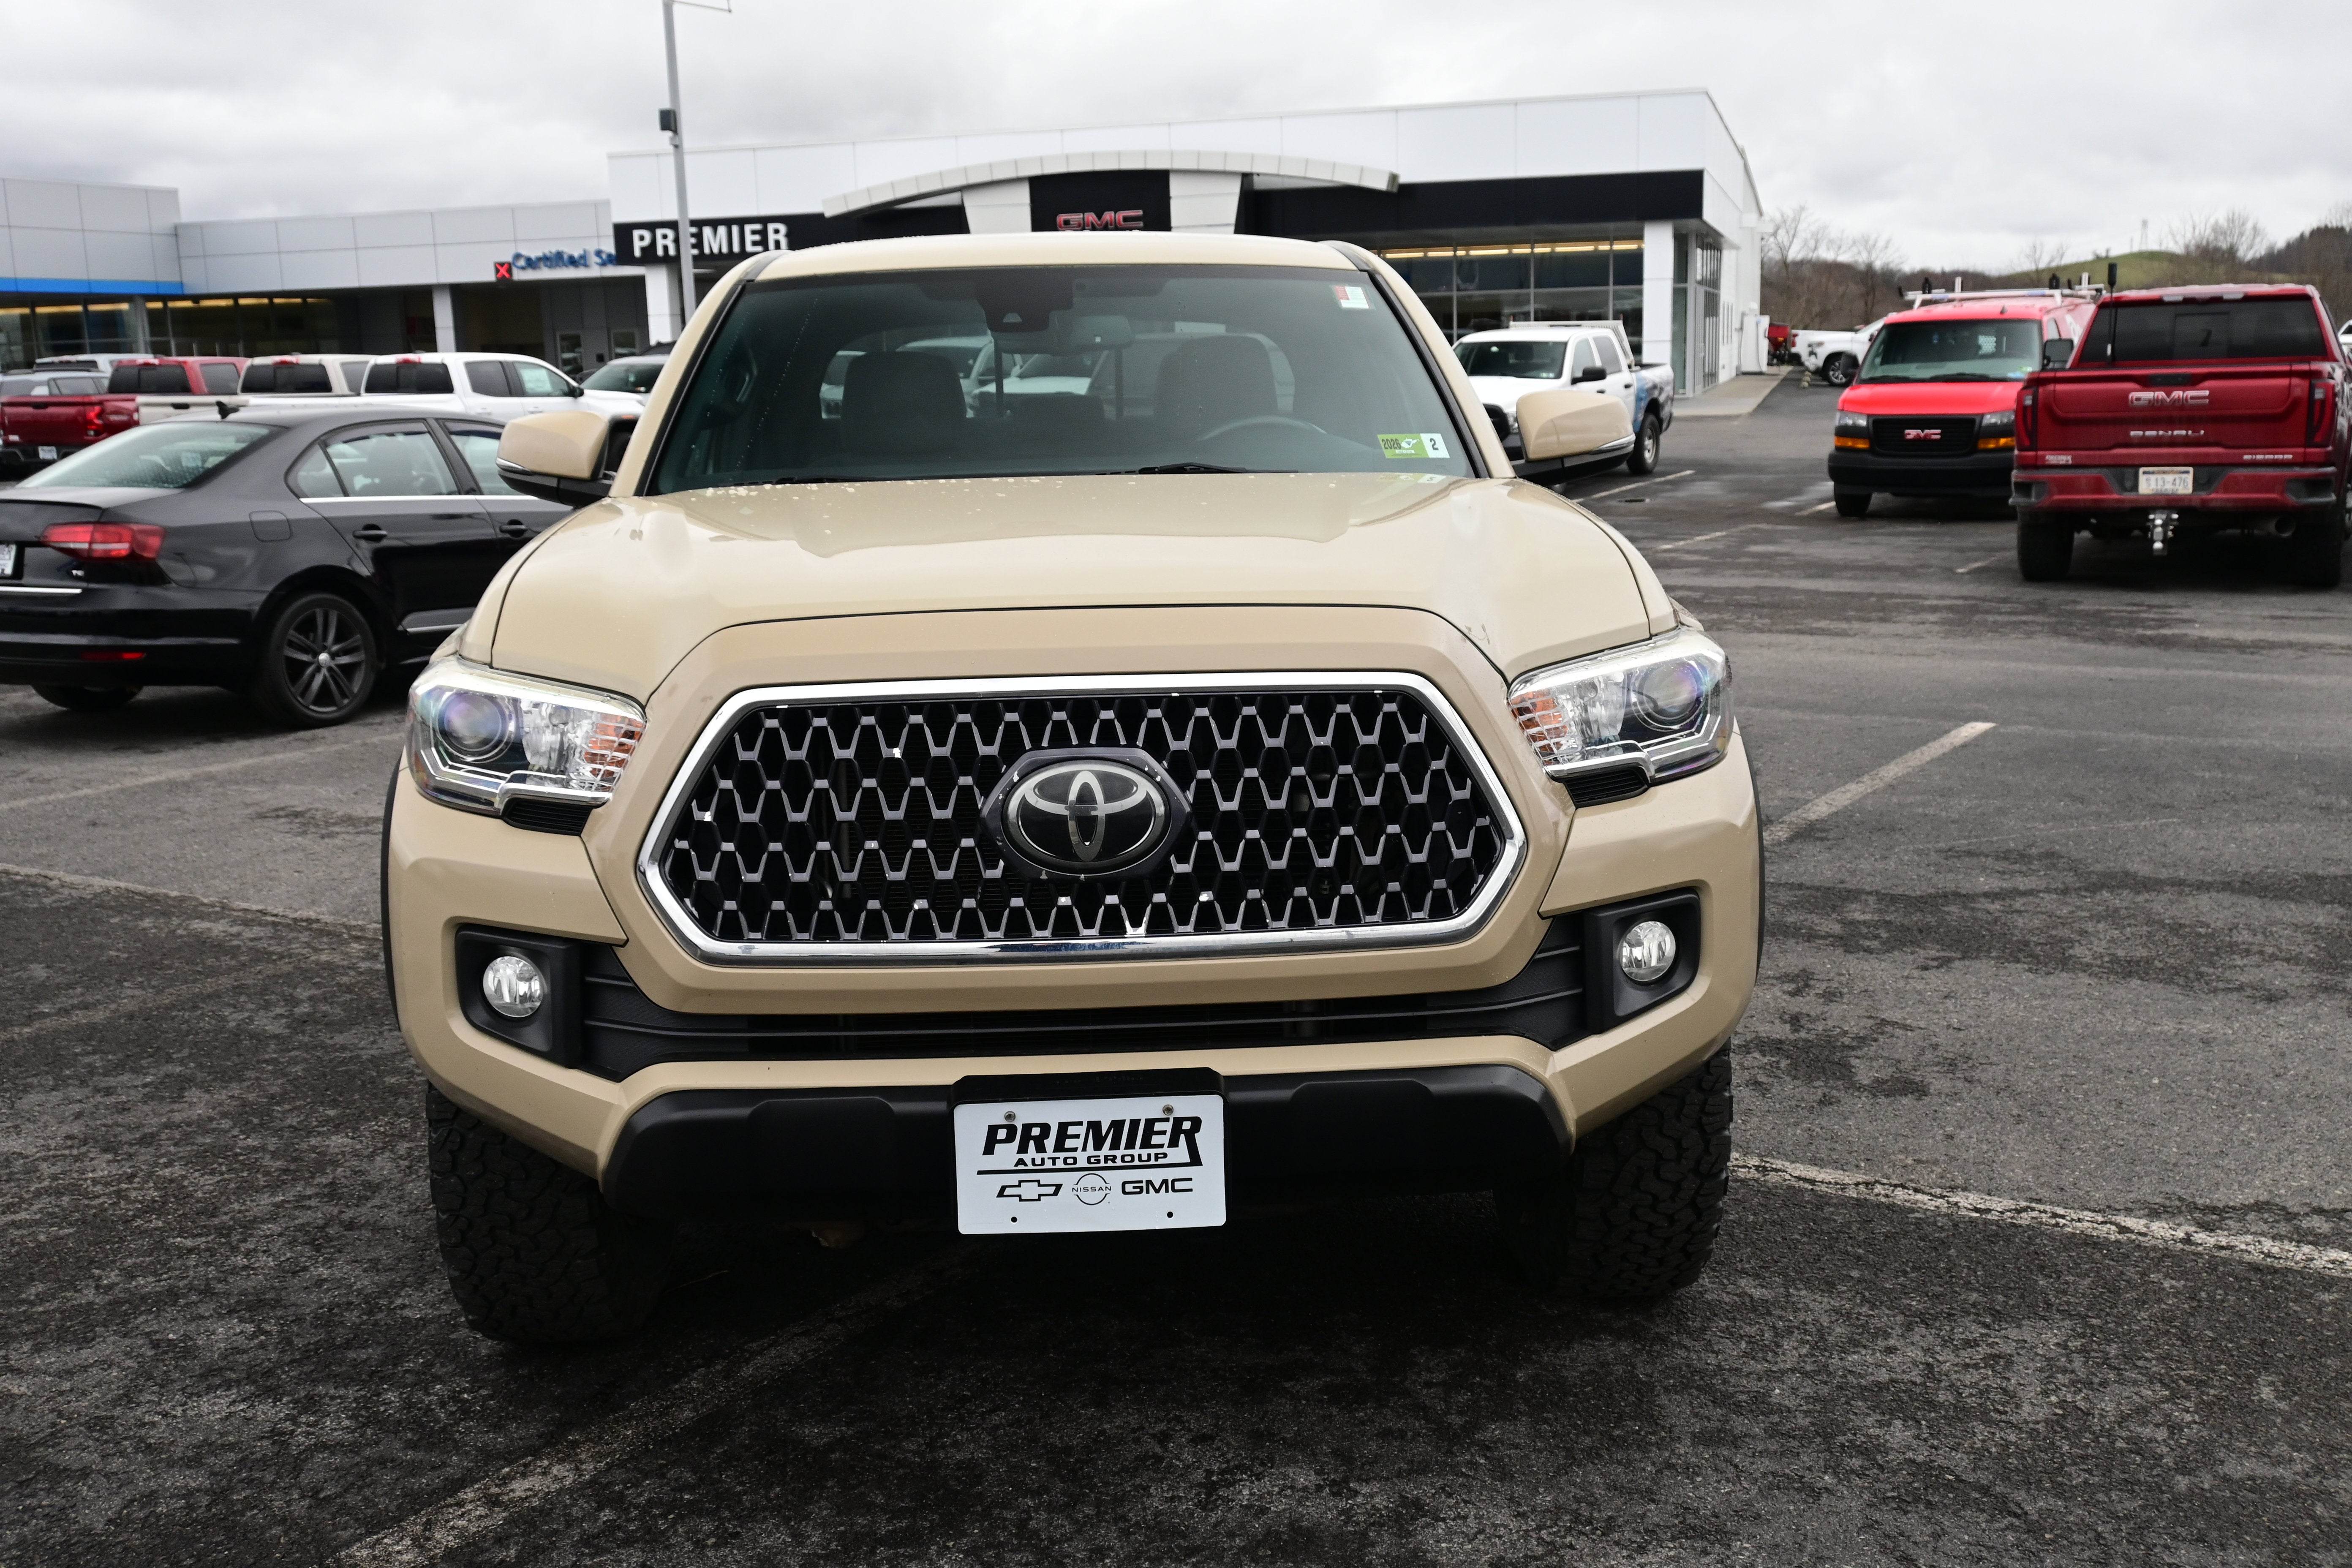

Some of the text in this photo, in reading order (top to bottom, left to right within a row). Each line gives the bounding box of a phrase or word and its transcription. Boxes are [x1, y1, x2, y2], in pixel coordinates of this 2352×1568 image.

[1056, 210, 1143, 230] GMC
[632, 223, 789, 258] PREMIER
[512, 248, 589, 270] Certified
[2129, 390, 2209, 406] GMC
[1904, 429, 1941, 439] GMC
[1382, 438, 1401, 449] 2026
[1430, 438, 1439, 450] 2
[982, 1116, 1203, 1166] PREMIER
[1014, 1152, 1168, 1167] AUTO GROUP
[1122, 1178, 1193, 1195] GMC
